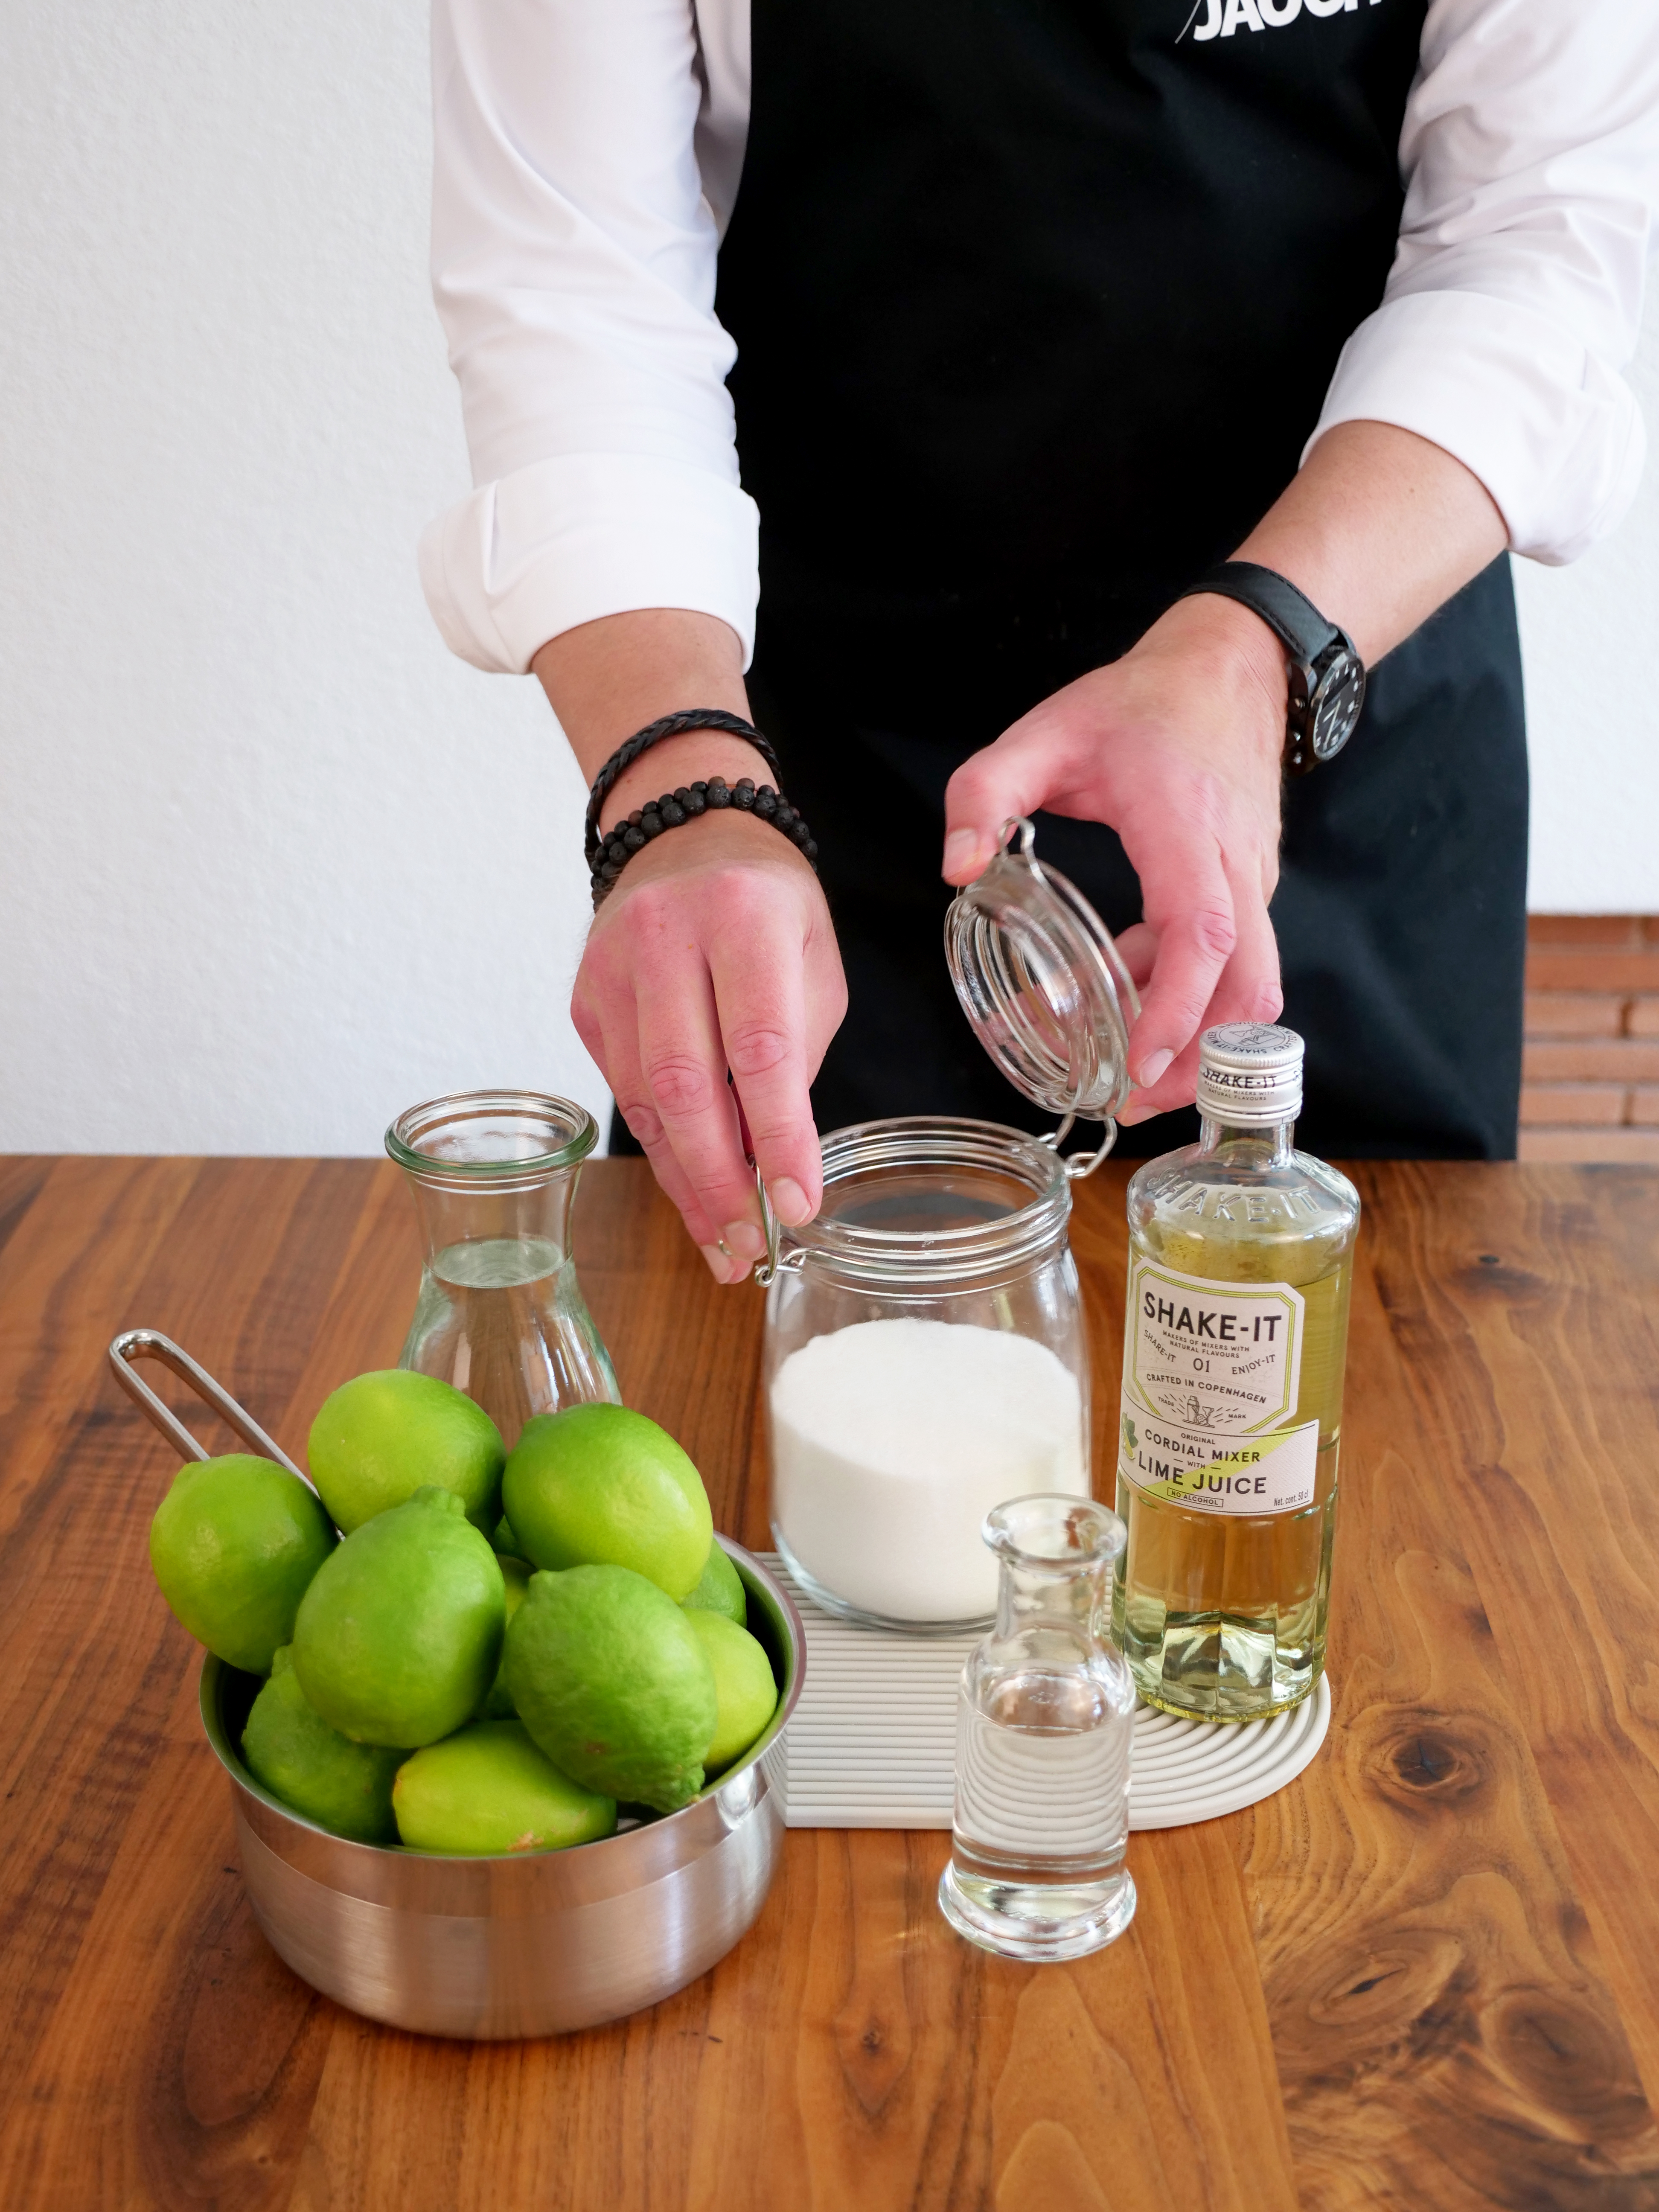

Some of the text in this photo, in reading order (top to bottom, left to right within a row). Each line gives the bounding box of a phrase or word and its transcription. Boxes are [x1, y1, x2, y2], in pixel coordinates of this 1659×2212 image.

[1207, 1030, 1221, 1045] MIXER
[1274, 1034, 1298, 1052] CRAFTED
[1203, 1068, 1277, 1089] SHAKE-IT
[1204, 1081, 1222, 1090] MAKERS
[1208, 1088, 1231, 1098] NATURAL
[1144, 1291, 1282, 1342] SHAKE-IT
[1144, 1329, 1176, 1363] SHARE-IT
[1163, 1330, 1187, 1342] MAKERS
[1202, 1342, 1228, 1351] MIXERS
[1170, 1340, 1240, 1359] NATURAL FLAVOURS
[1231, 1354, 1276, 1375] ENJOY-IT
[1146, 1373, 1182, 1385] CRAFTED
[1198, 1382, 1267, 1404] COPENHAGEN
[1158, 1396, 1175, 1407] TRADE
[1145, 1429, 1260, 1462] CORDIAL MIXER
[1180, 1432, 1216, 1445] ORIGINAL
[1138, 1450, 1267, 1494] LIME JUICE
[1187, 1460, 1206, 1469] WITH
[1183, 1493, 1219, 1506] ALCOHOL
[1274, 1497, 1284, 1507] Net.
[1285, 1494, 1297, 1503] cont.
[1298, 1491, 1304, 1500] 50
